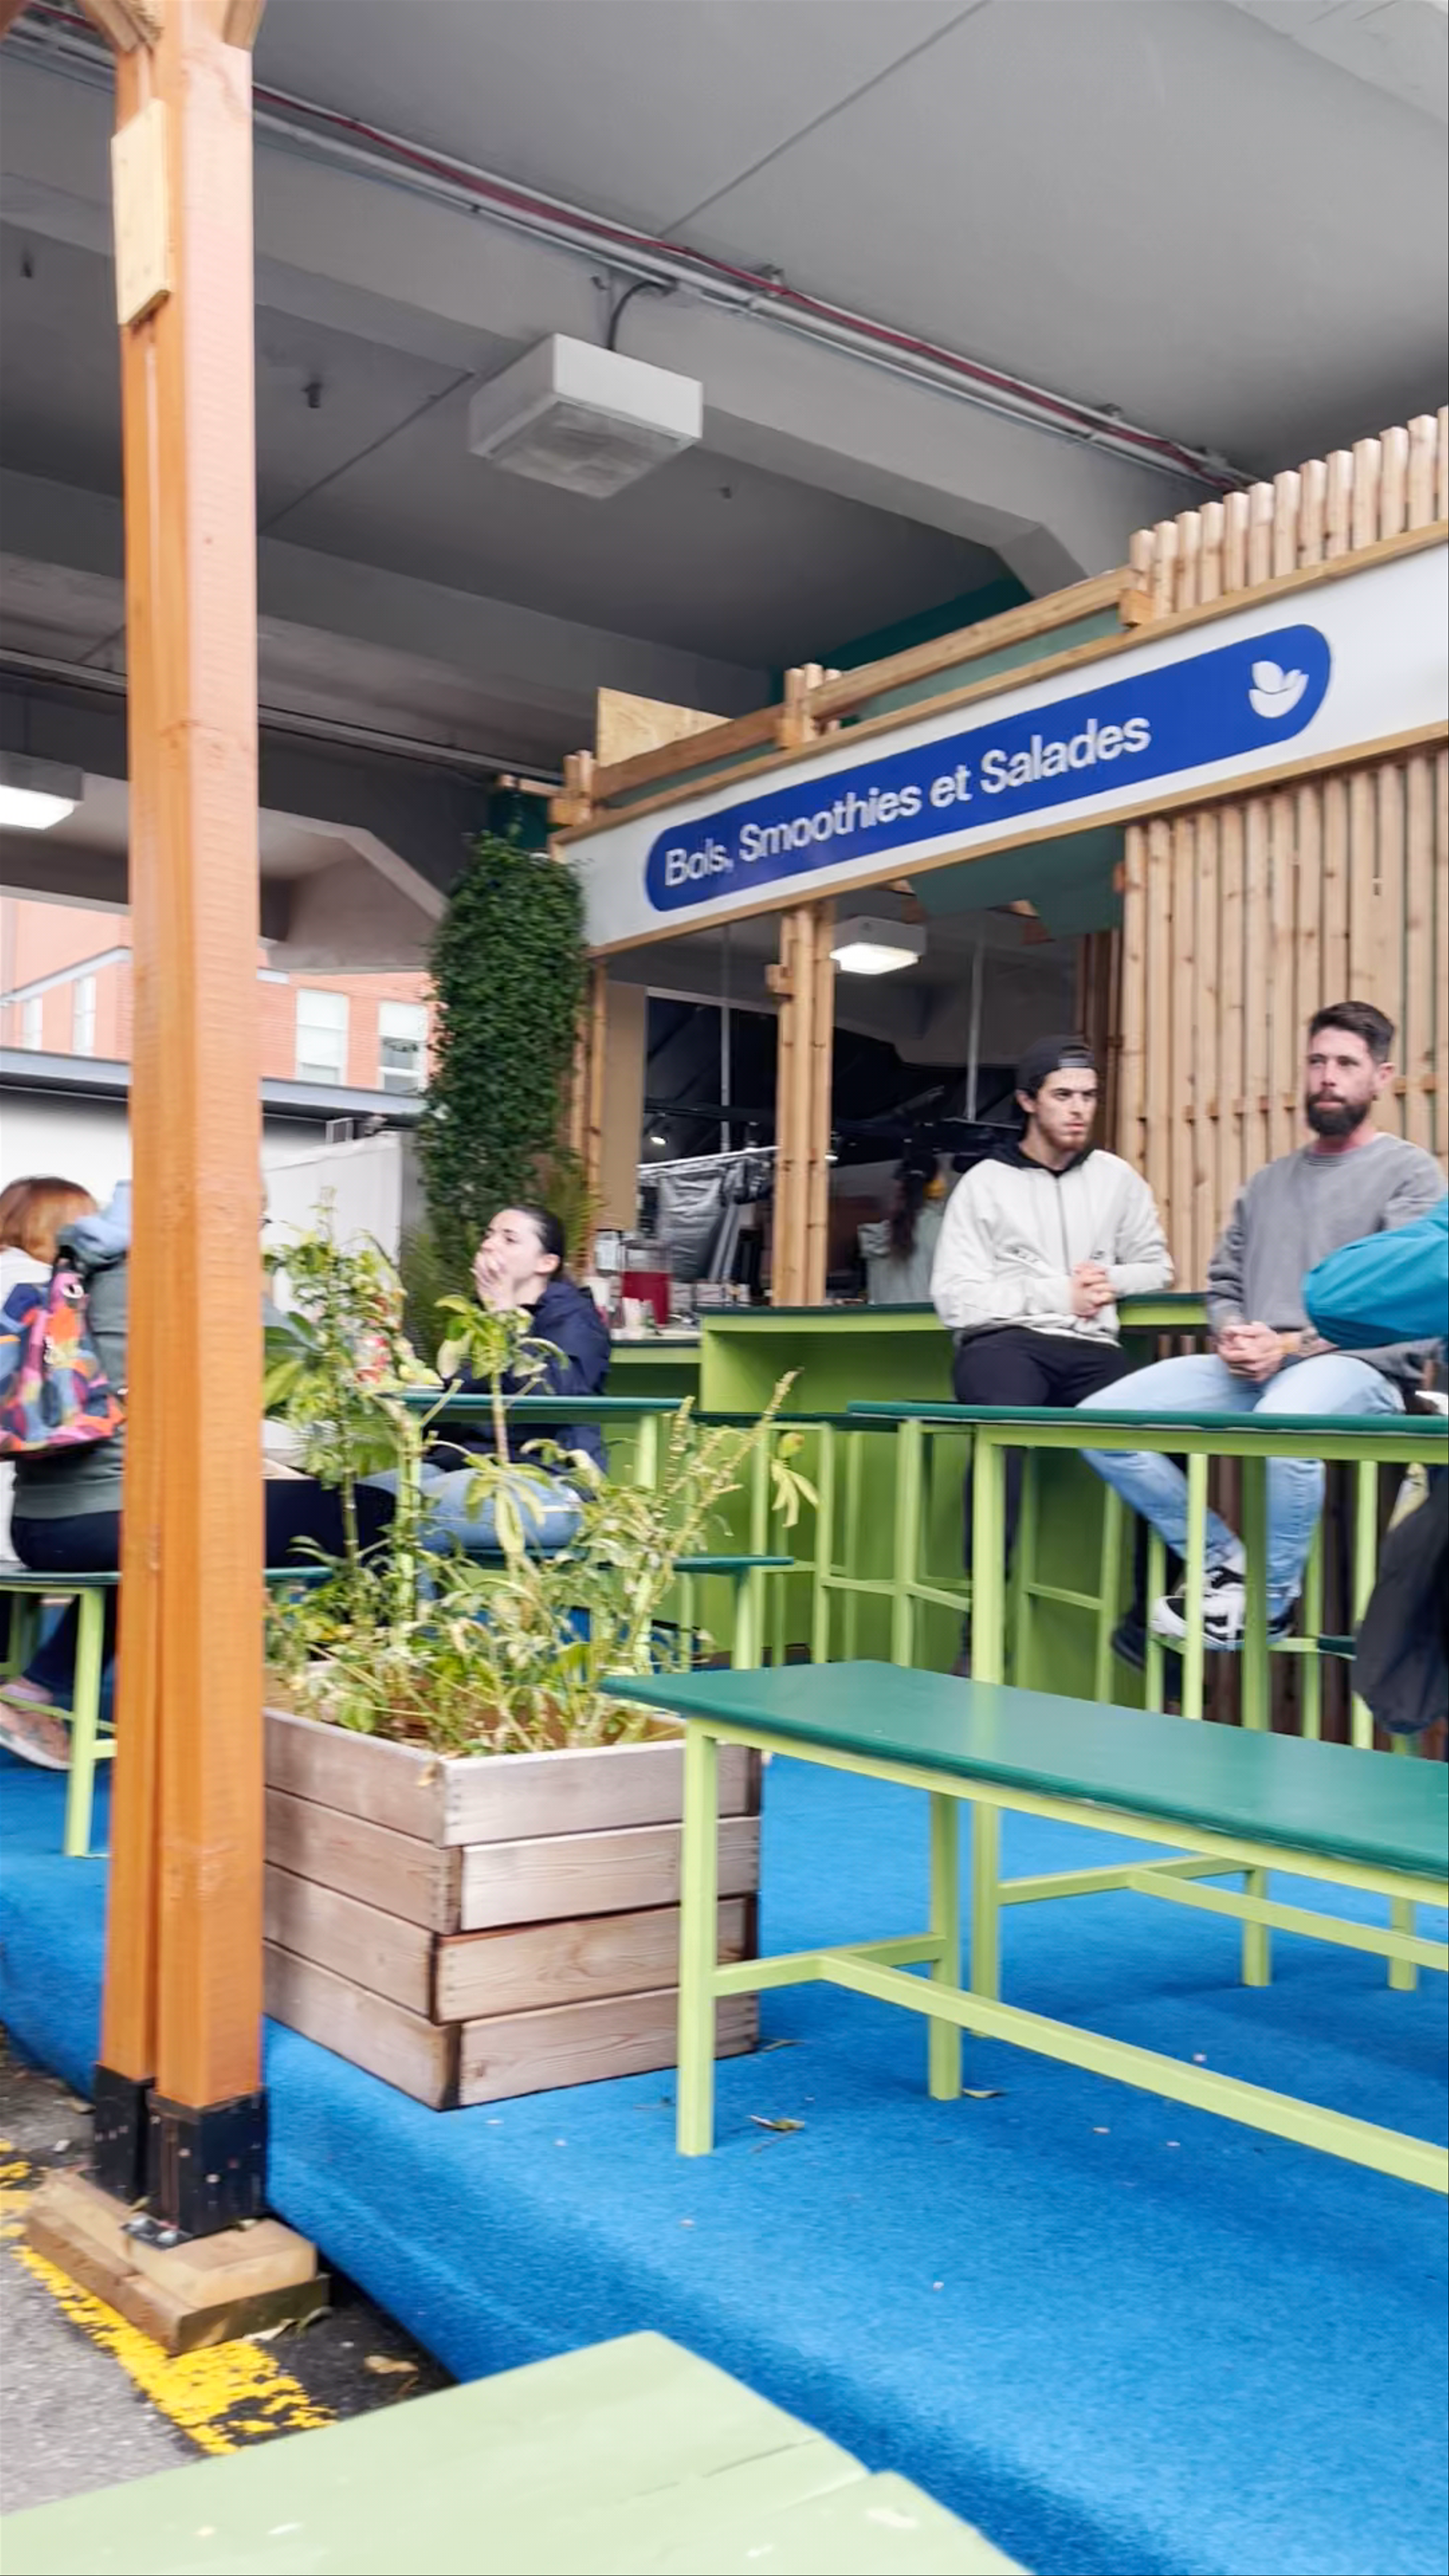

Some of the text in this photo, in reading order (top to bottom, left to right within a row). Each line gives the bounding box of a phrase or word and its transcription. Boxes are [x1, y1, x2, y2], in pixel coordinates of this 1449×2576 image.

[665, 717, 1151, 886] Bols, Smoothies et Salades
